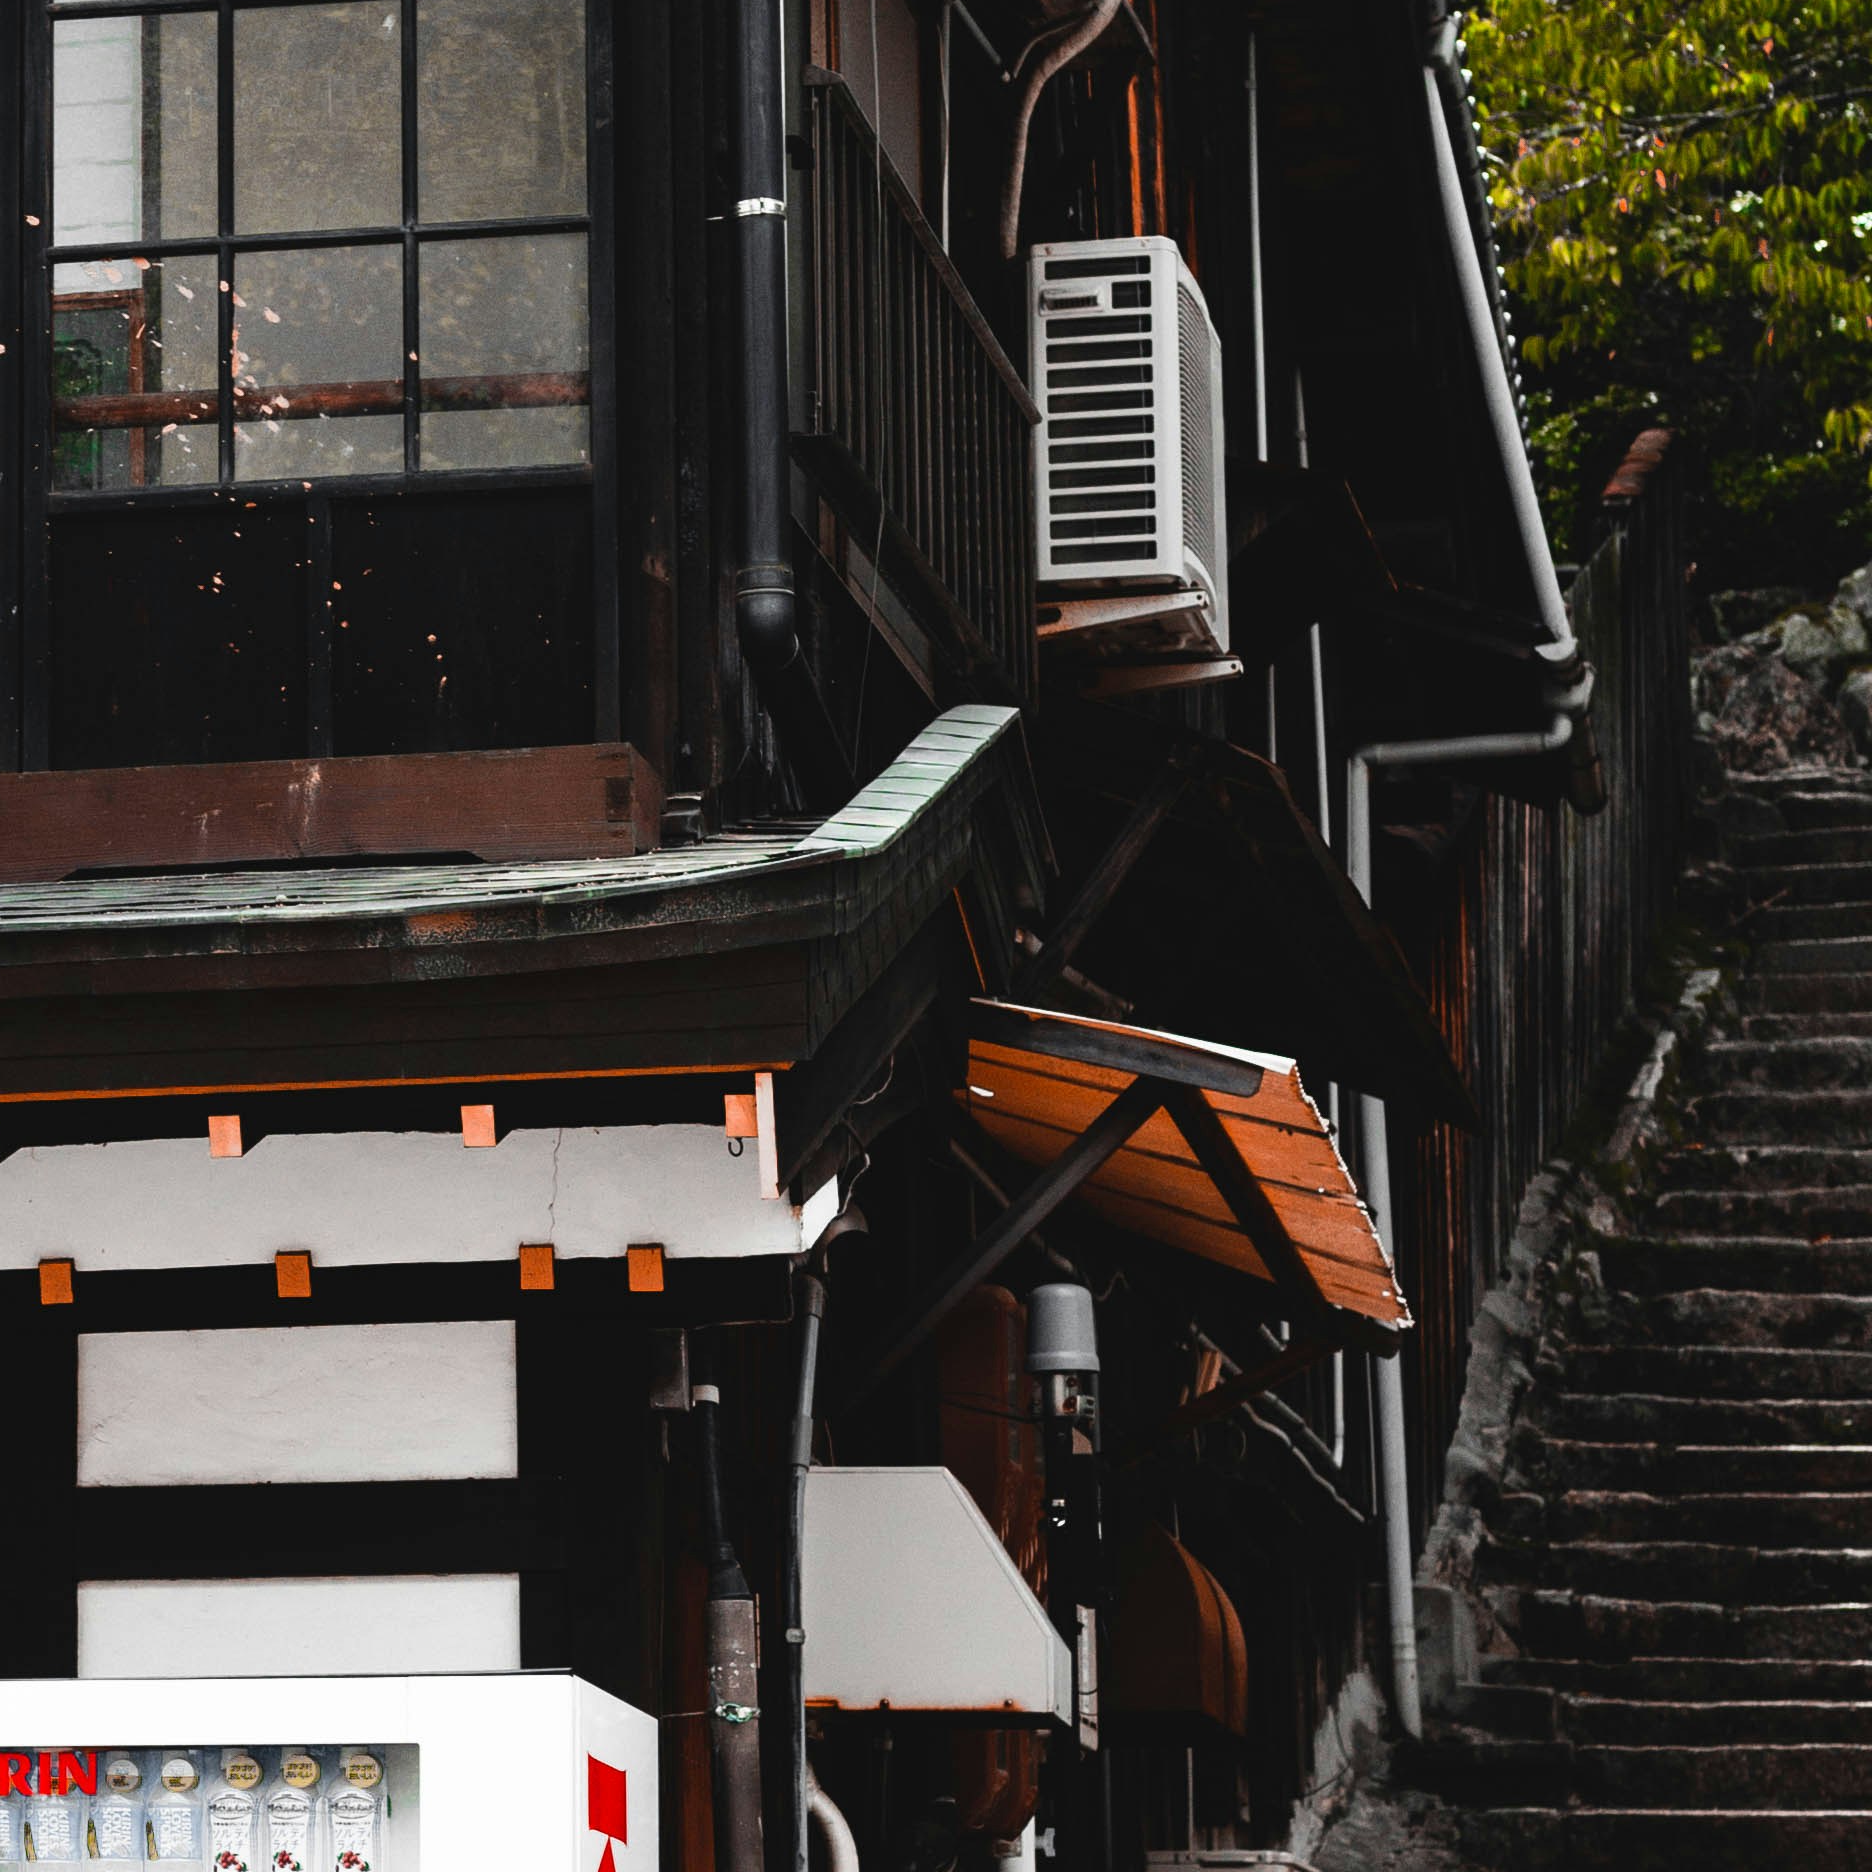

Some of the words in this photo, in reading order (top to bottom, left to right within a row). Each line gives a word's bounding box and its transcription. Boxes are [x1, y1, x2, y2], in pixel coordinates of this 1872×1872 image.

[0, 1809, 10, 1847] KIRIN
[38, 1809, 48, 1858] SPORTS
[59, 1809, 70, 1847] KIRIN
[102, 1807, 112, 1856] SPORTS
[121, 1807, 131, 1844] KIRIN
[160, 1808, 170, 1856] SPORTS
[182, 1808, 192, 1844] KIRIN
